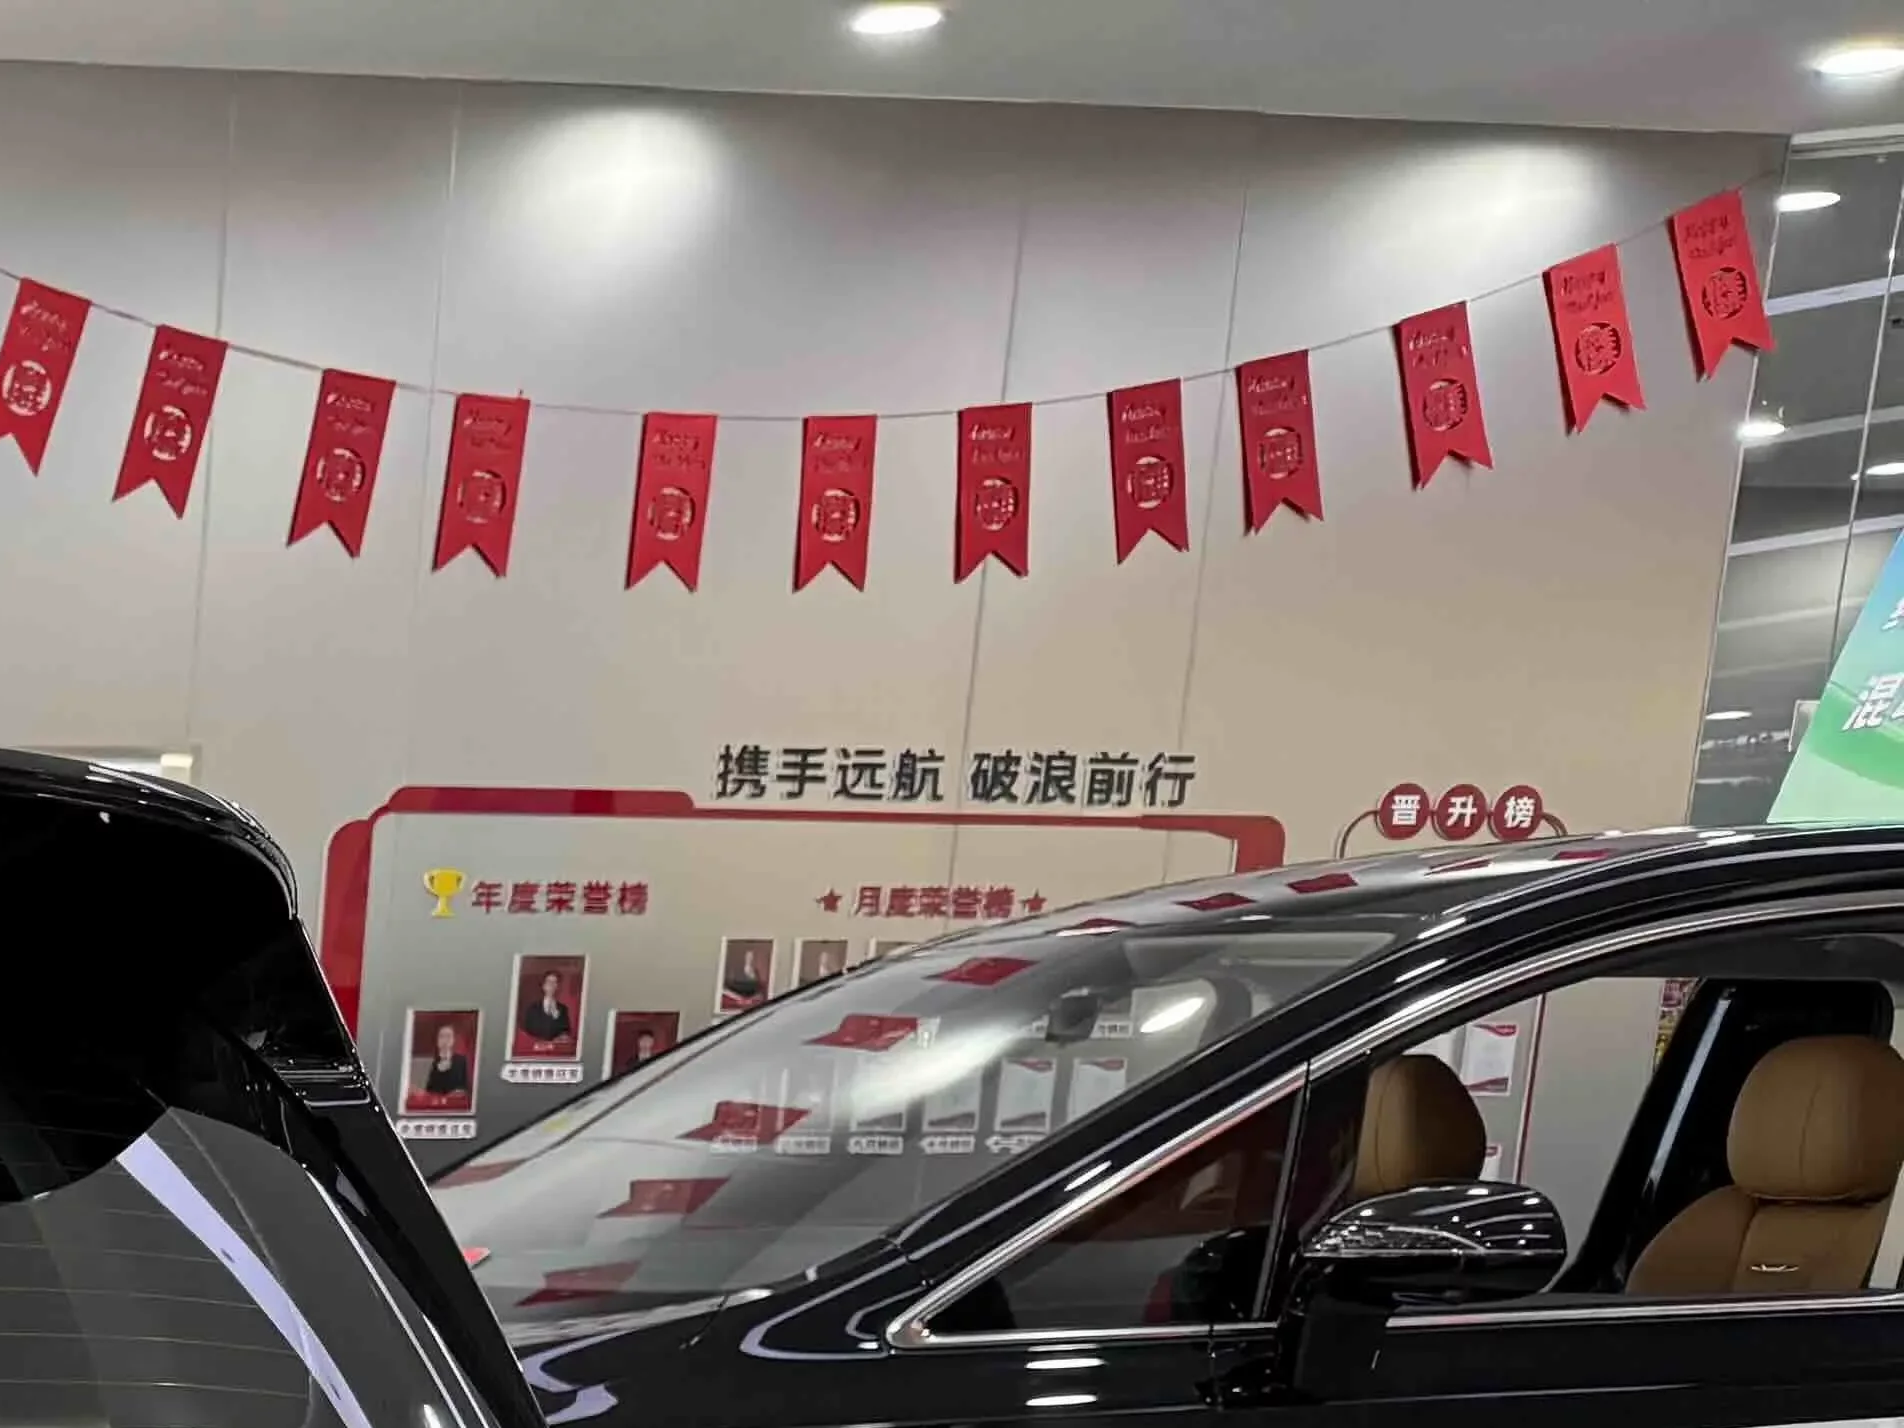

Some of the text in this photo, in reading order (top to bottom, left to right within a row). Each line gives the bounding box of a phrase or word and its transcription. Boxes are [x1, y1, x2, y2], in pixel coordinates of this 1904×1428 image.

[716, 743, 1196, 807] 携手远航 破浪前行
[1390, 793, 1536, 829] 晋升榜
[471, 879, 649, 915] 年度荣誉榜
[854, 884, 1016, 919] 月度荣誉榜
